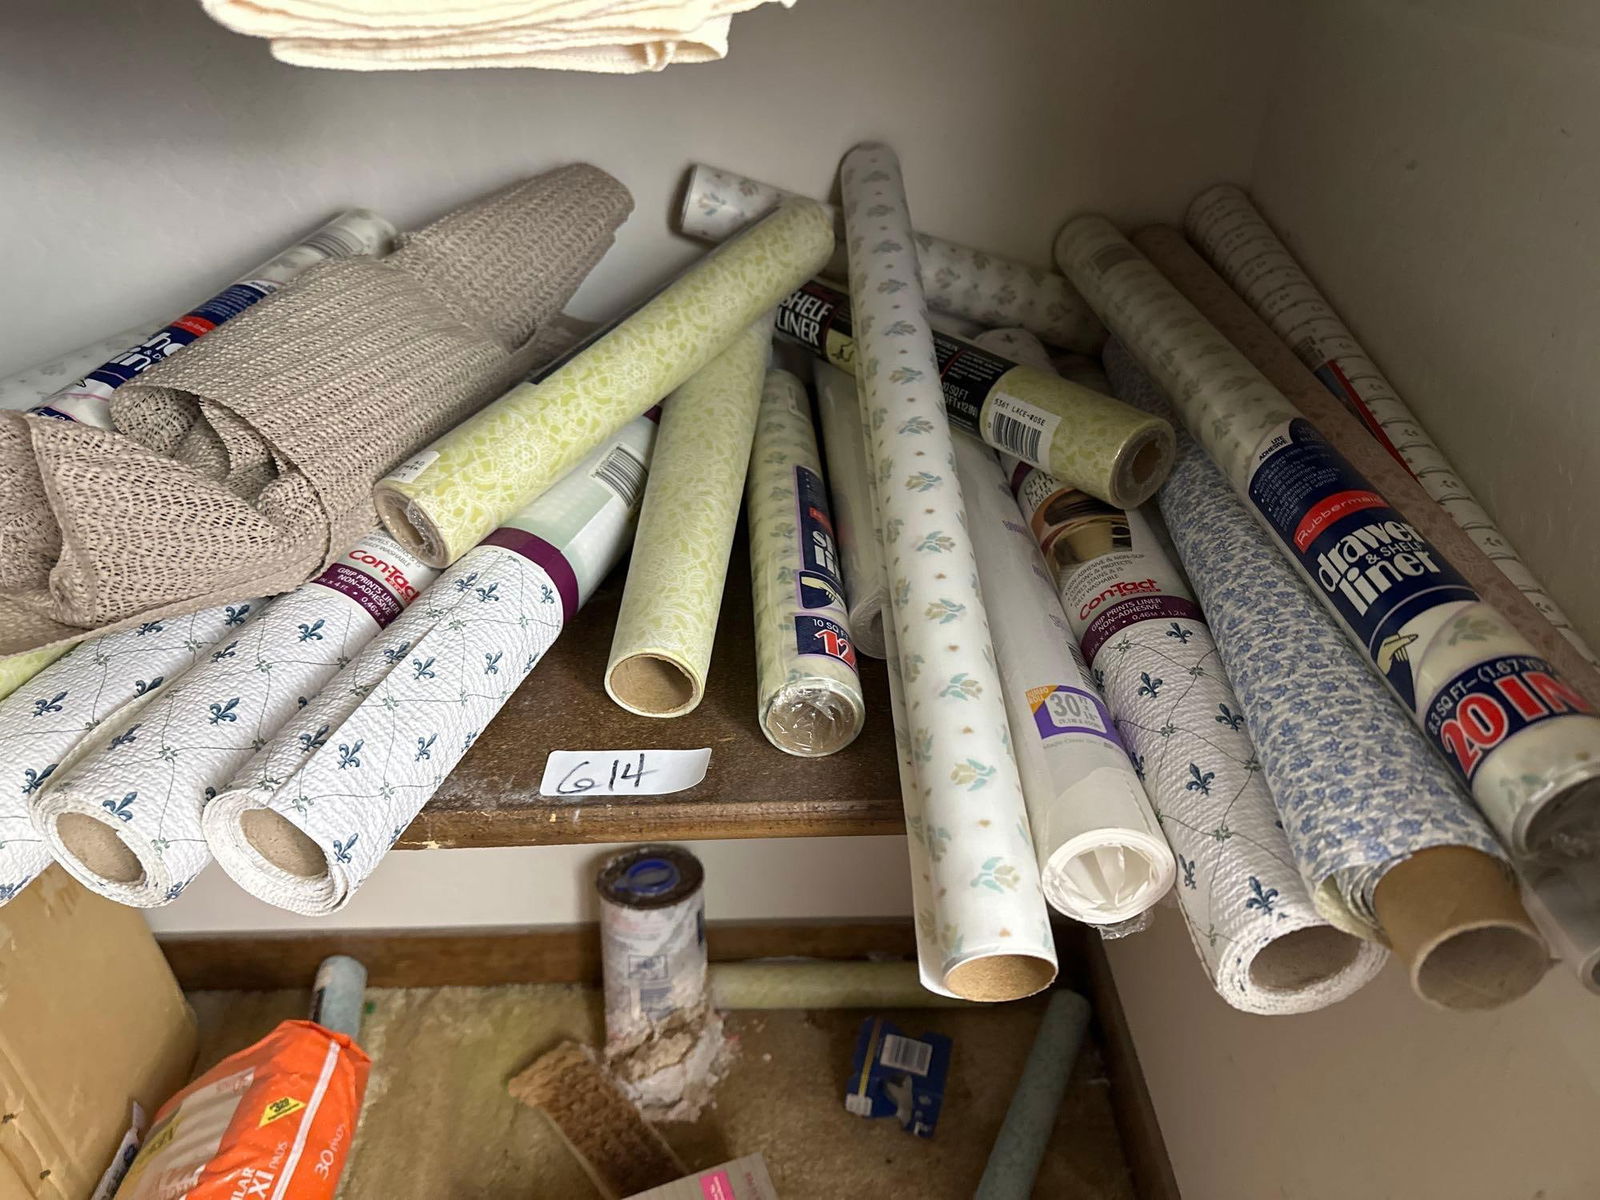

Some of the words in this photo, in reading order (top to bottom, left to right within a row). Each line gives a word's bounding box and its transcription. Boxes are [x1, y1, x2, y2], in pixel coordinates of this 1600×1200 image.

[776, 306, 820, 347] LINER
[1317, 521, 1425, 592] drawer
[1365, 553, 1381, 565] &
[337, 567, 358, 578] GRIP
[356, 574, 384, 595] PRINTS
[381, 592, 401, 614] LINER
[337, 574, 392, 616] NON-ADHESIVE
[1338, 551, 1441, 617] liner
[813, 619, 824, 627] 10
[1091, 614, 1107, 632] GRIP
[1105, 602, 1136, 618] PRINTS
[1136, 598, 1163, 606] LINER
[1097, 603, 1162, 633] NON-ADHESIVE
[1049, 693, 1081, 718] 30
[1436, 695, 1454, 718] SQ
[1440, 692, 1510, 781] 20
[314, 1148, 335, 1181] 30
